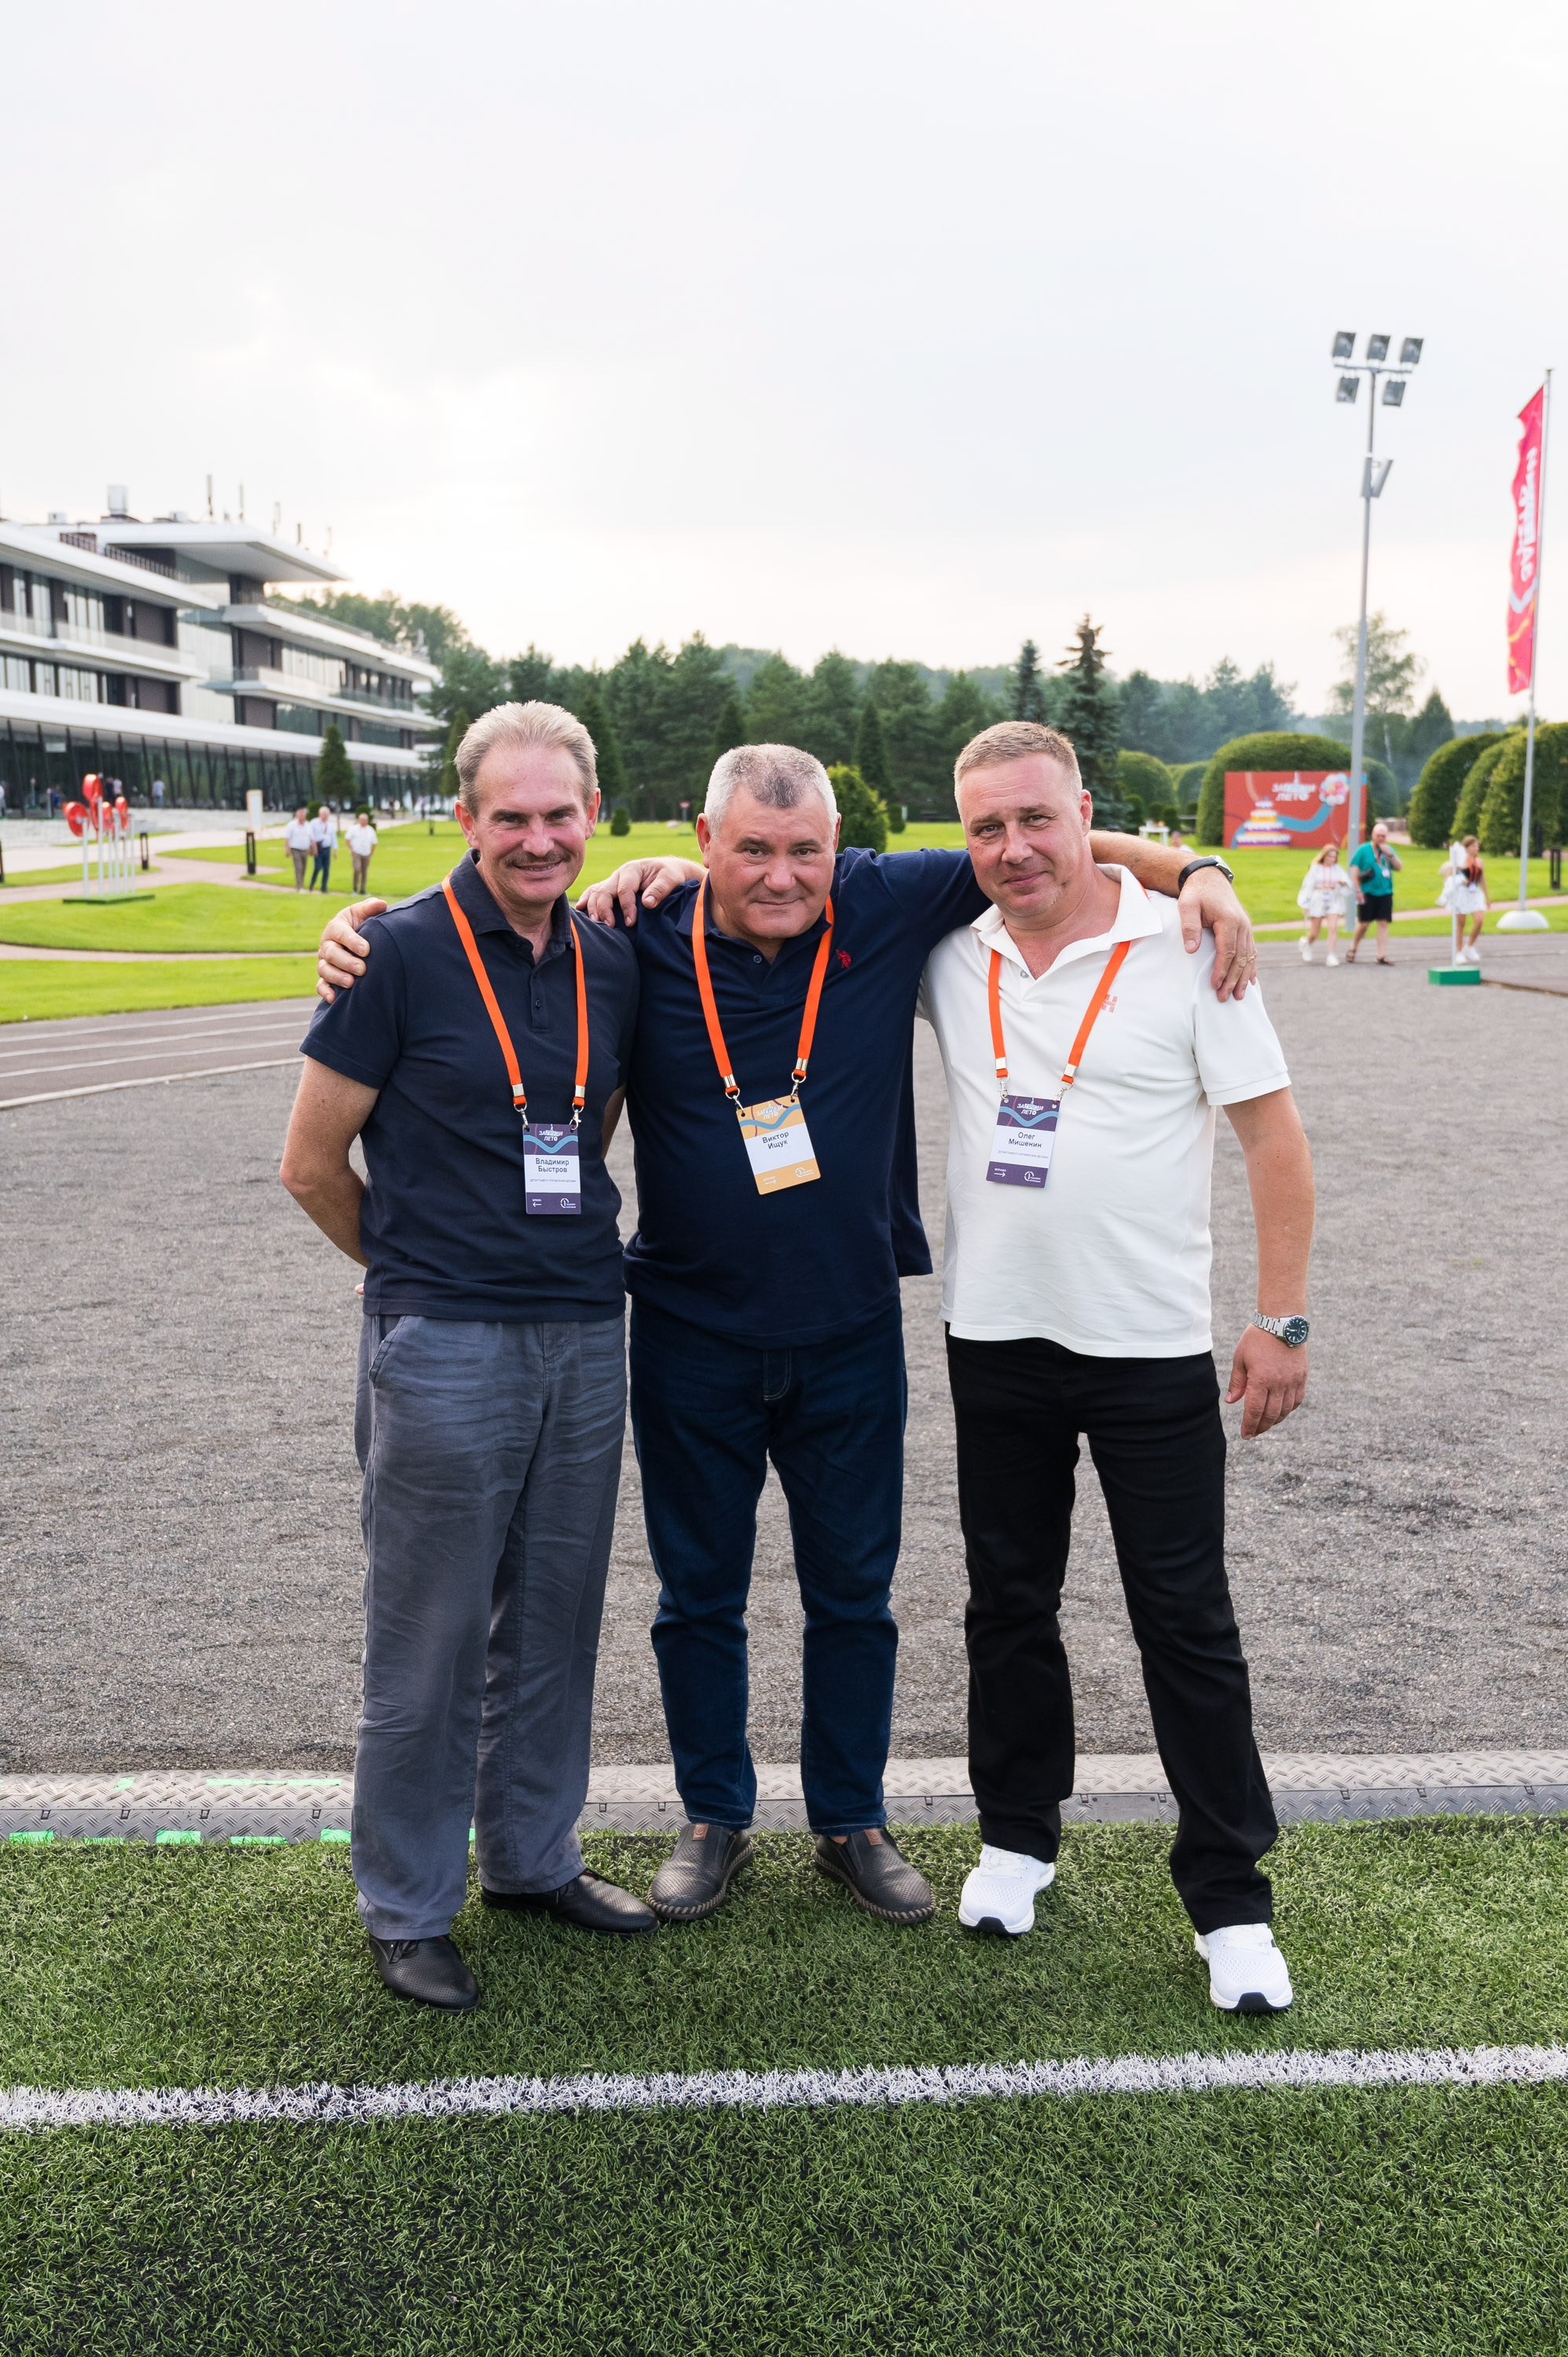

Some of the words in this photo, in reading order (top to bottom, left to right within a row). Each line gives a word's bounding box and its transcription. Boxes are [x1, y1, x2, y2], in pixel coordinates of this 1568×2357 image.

[762, 1131, 789, 1144] Виктор
[1017, 1131, 1035, 1140] Олег
[768, 1139, 788, 1149] Ищук
[1008, 1138, 1042, 1149] Мишенин
[535, 1157, 570, 1166] Владимир
[538, 1165, 567, 1174] Быстров
